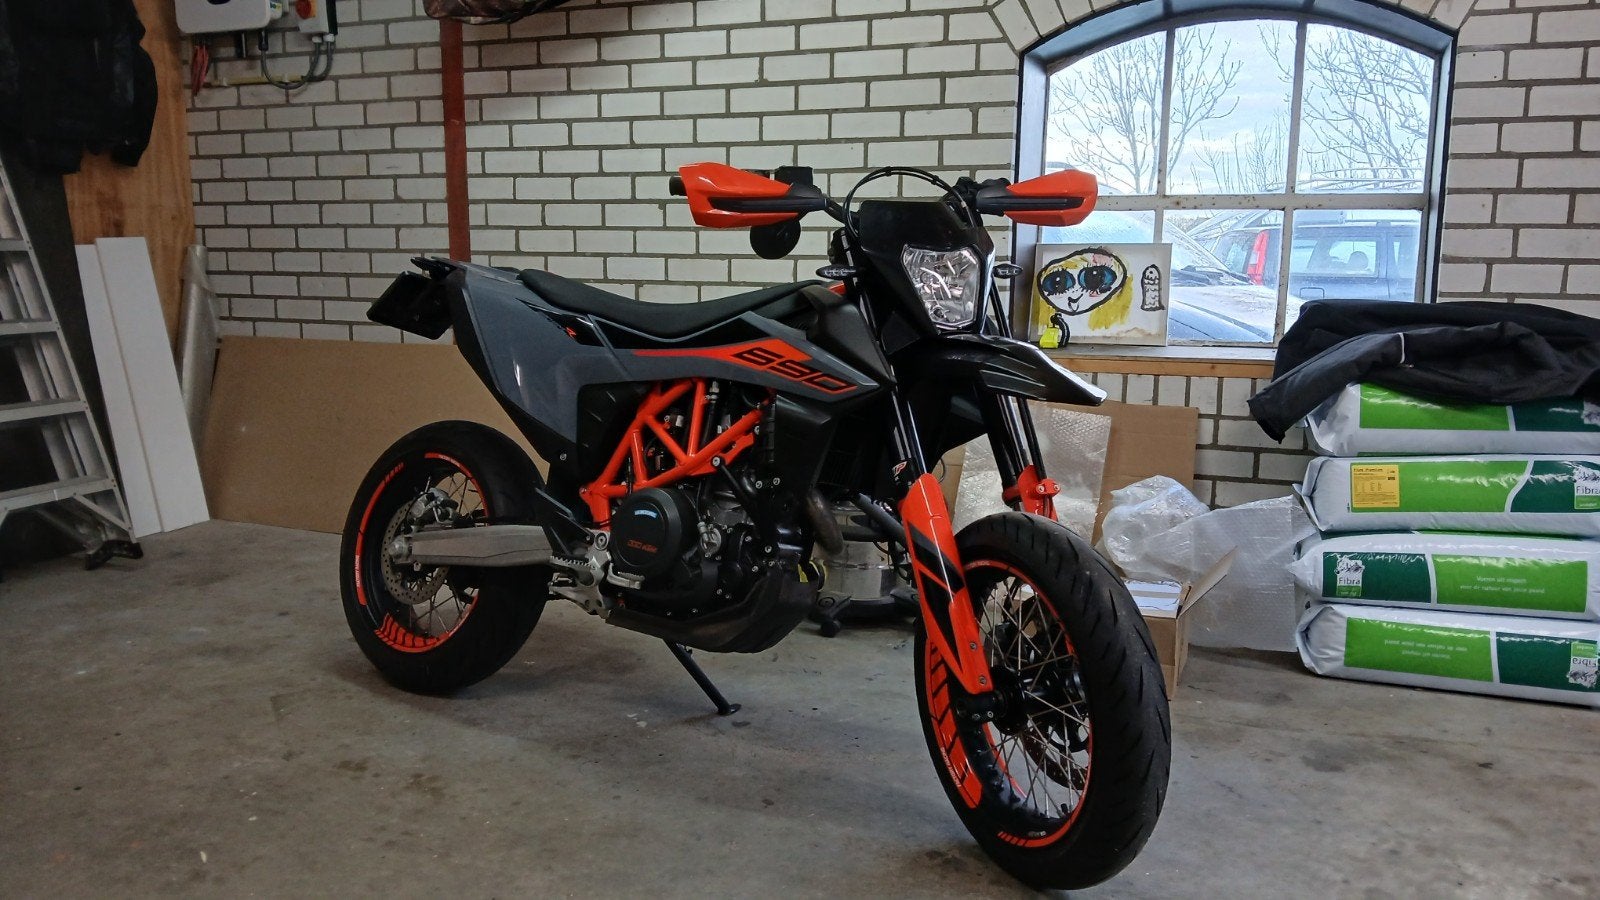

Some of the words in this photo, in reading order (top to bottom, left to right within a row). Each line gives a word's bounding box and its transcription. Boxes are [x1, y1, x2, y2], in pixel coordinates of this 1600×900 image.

[731, 346, 858, 395] 690
[1338, 576, 1361, 585] Fibra
[1572, 657, 1597, 668] Fibra
